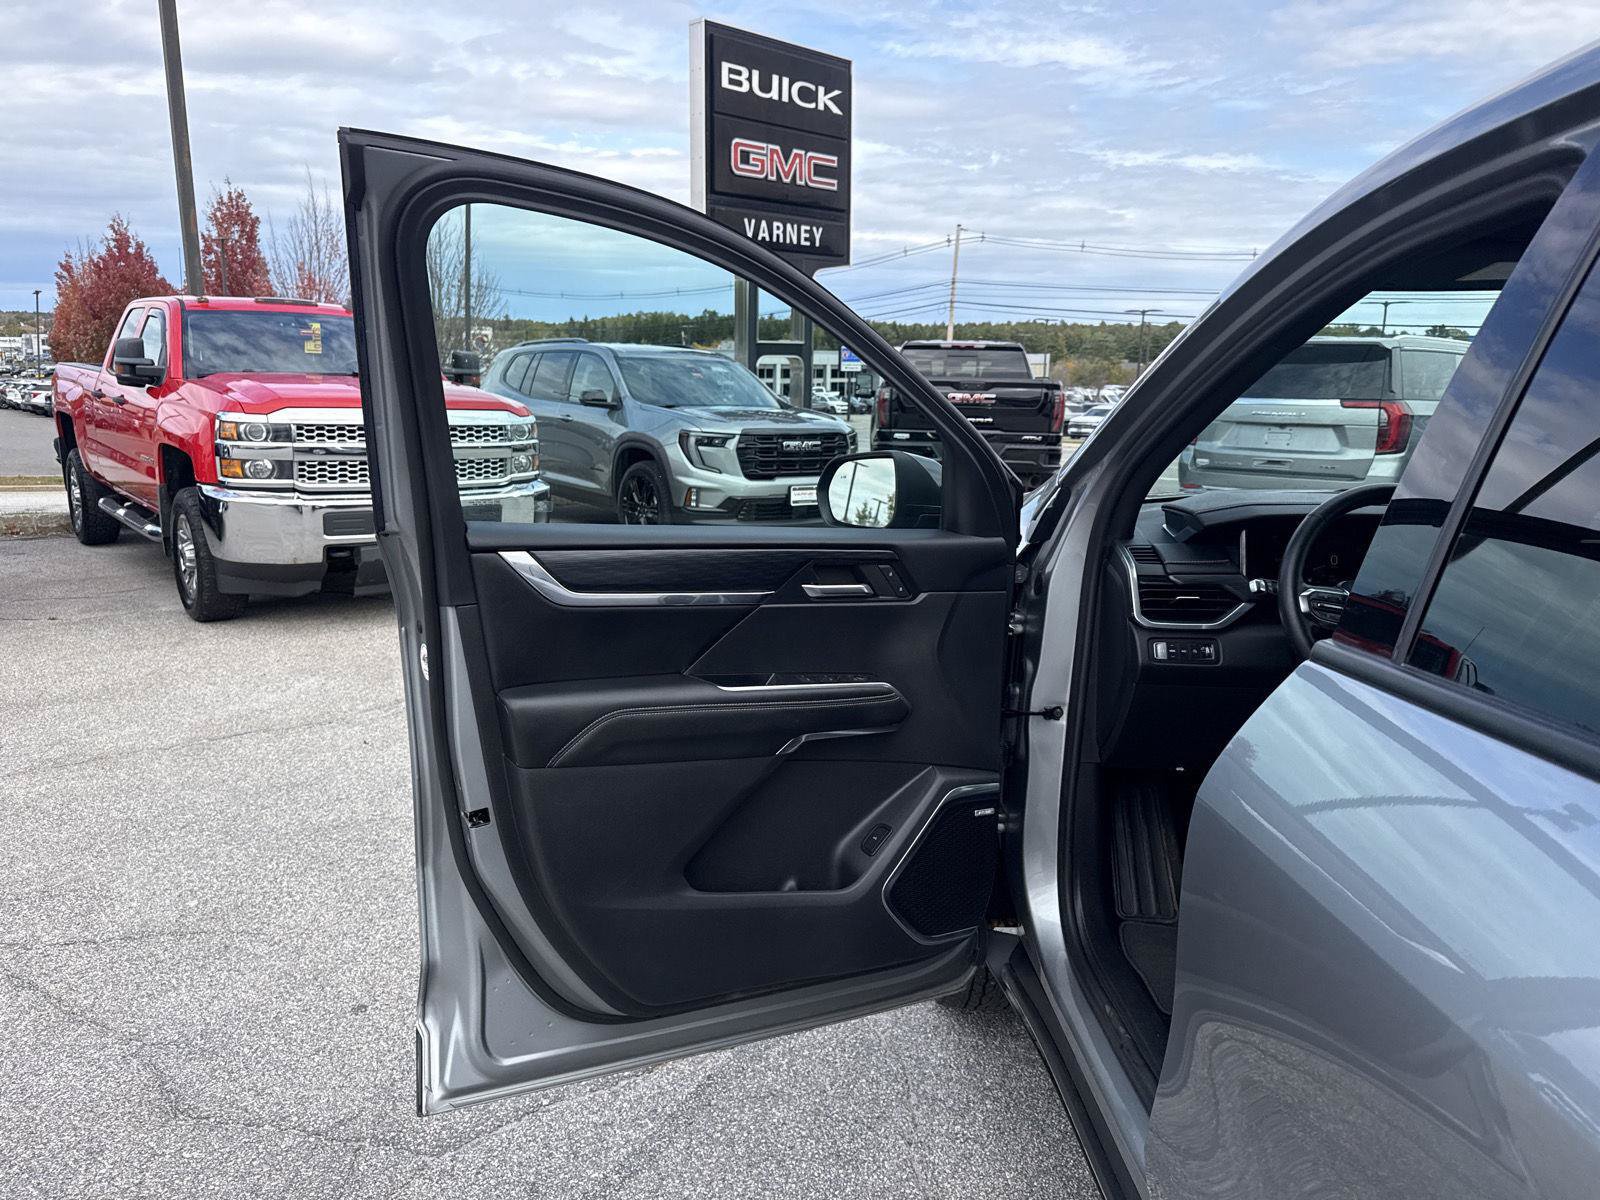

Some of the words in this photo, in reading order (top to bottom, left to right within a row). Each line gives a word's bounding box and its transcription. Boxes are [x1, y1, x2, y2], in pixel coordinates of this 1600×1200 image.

[721, 60, 843, 116] BUICK
[731, 137, 838, 191] GMC
[743, 217, 823, 247] VARNEY
[947, 392, 997, 404] GMC
[782, 440, 822, 452] GMC
